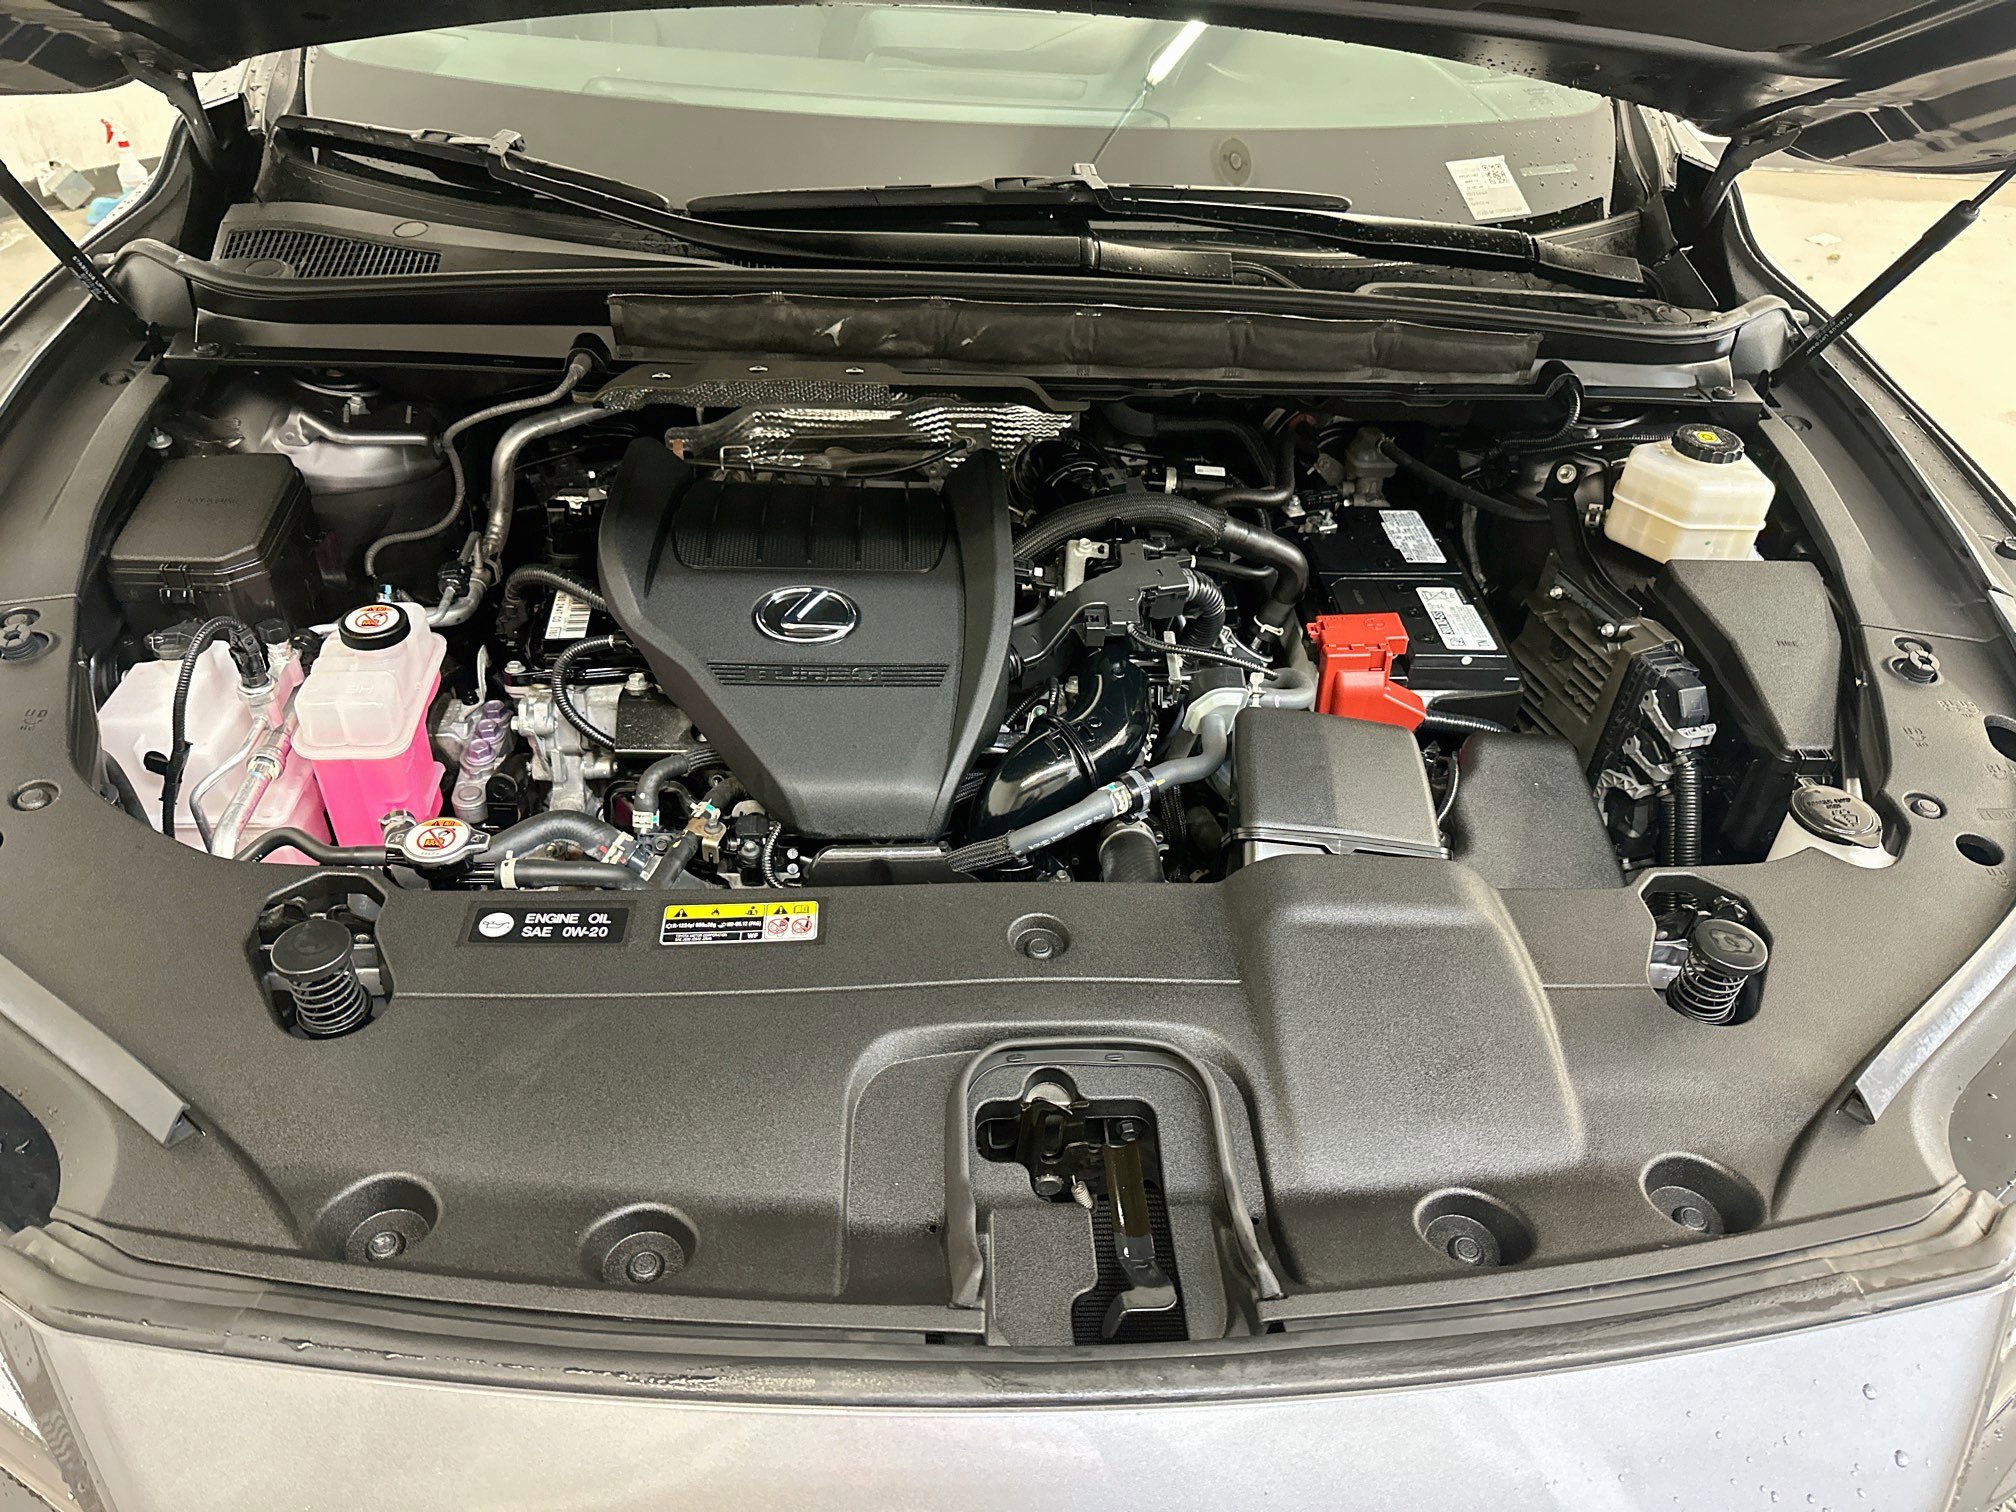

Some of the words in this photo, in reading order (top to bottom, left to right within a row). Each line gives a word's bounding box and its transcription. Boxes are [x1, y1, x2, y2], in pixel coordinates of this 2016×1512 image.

[72, 255, 96, 281] STABILUS
[748, 663, 879, 682] TURBO
[524, 913, 580, 924] ENGINE
[588, 913, 612, 924] OIL
[521, 926, 553, 938] SAE
[562, 926, 609, 938] 0W-20
